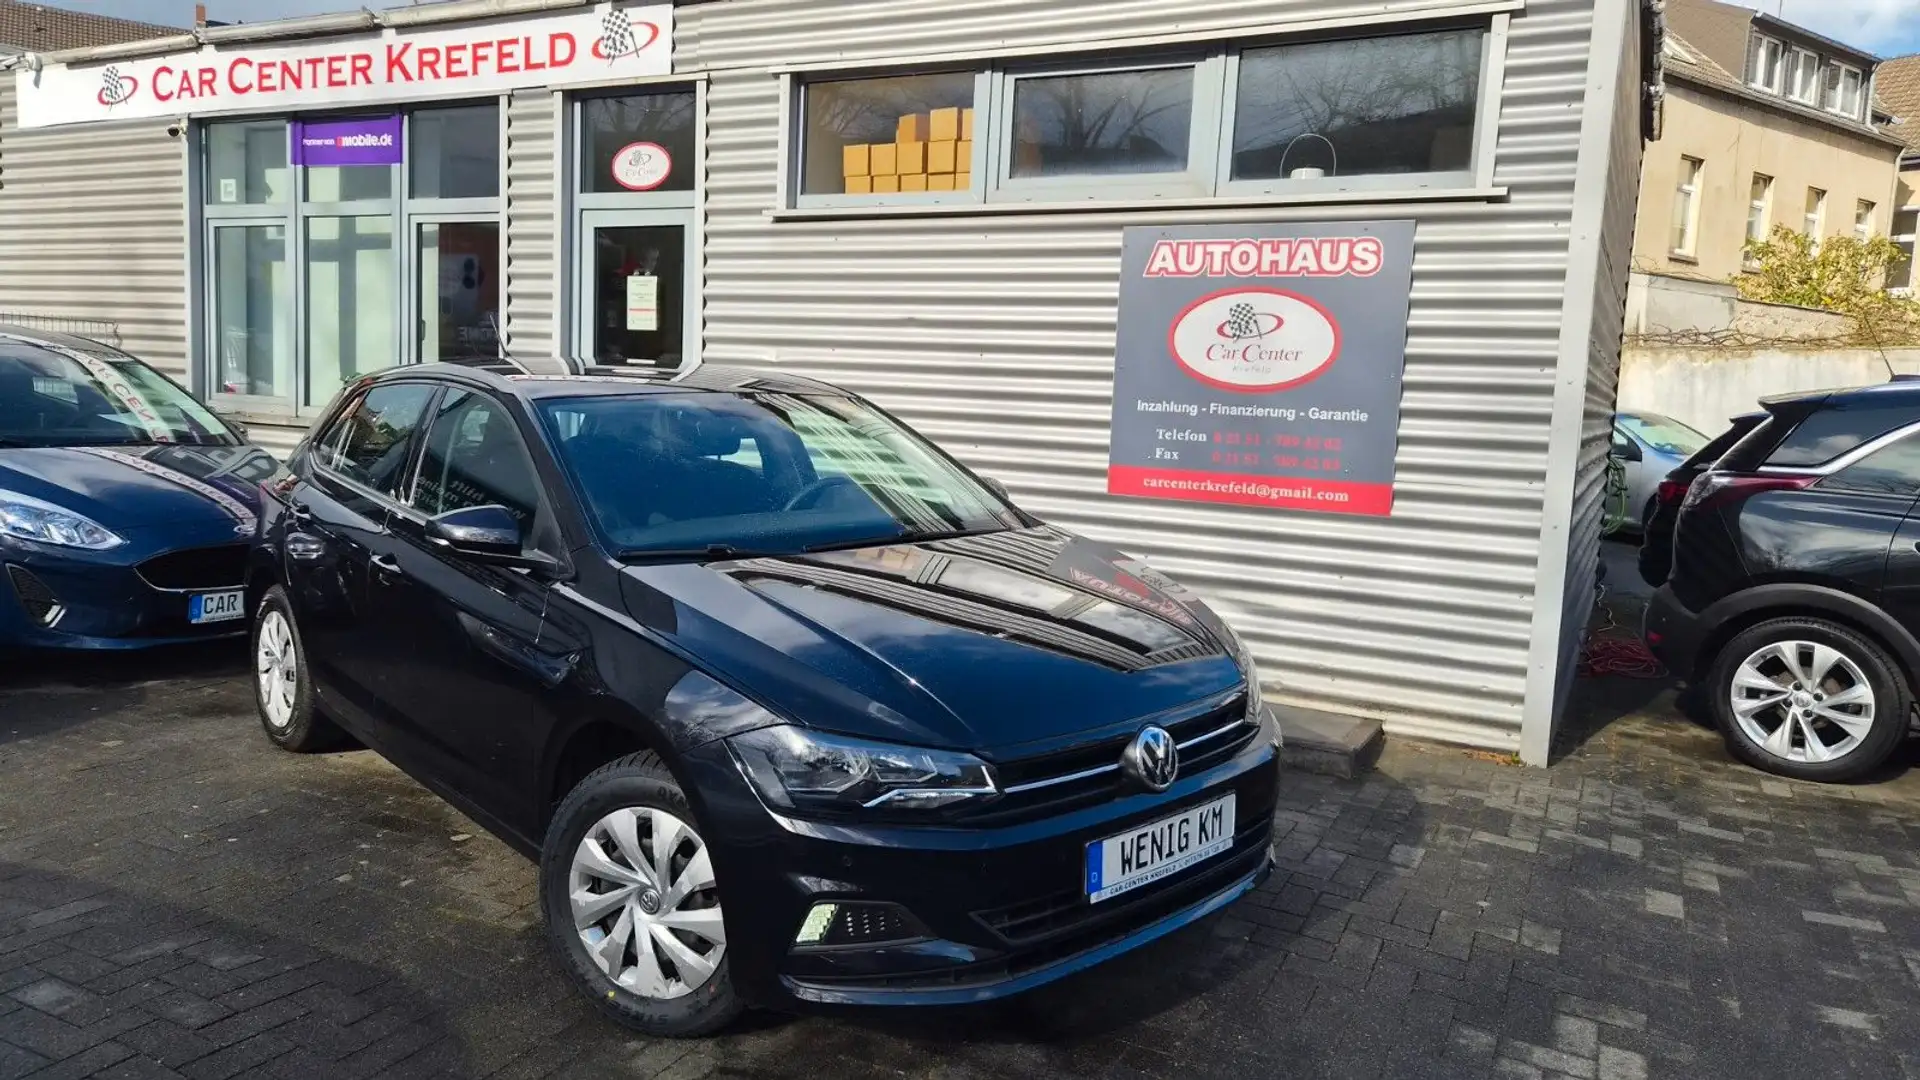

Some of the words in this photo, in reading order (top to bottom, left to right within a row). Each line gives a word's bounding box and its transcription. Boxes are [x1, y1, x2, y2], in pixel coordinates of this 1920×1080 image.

[152, 66, 217, 101] CAR
[228, 54, 373, 95] CENTER
[386, 32, 577, 83] KREFELD
[1144, 237, 1383, 277] AUTOHAUS
[1137, 400, 1198, 416] Inzahlung
[1209, 402, 1296, 421] Finanzierung
[1308, 407, 1369, 422] Garantie
[1156, 428, 1207, 442] Telefon
[1155, 448, 1180, 461] Fax
[1143, 476, 1349, 502] carcenterkrefeld@gmail.com
[204, 594, 237, 614] CAR
[1121, 818, 1189, 876] WENIG
[1199, 803, 1223, 845] KM
